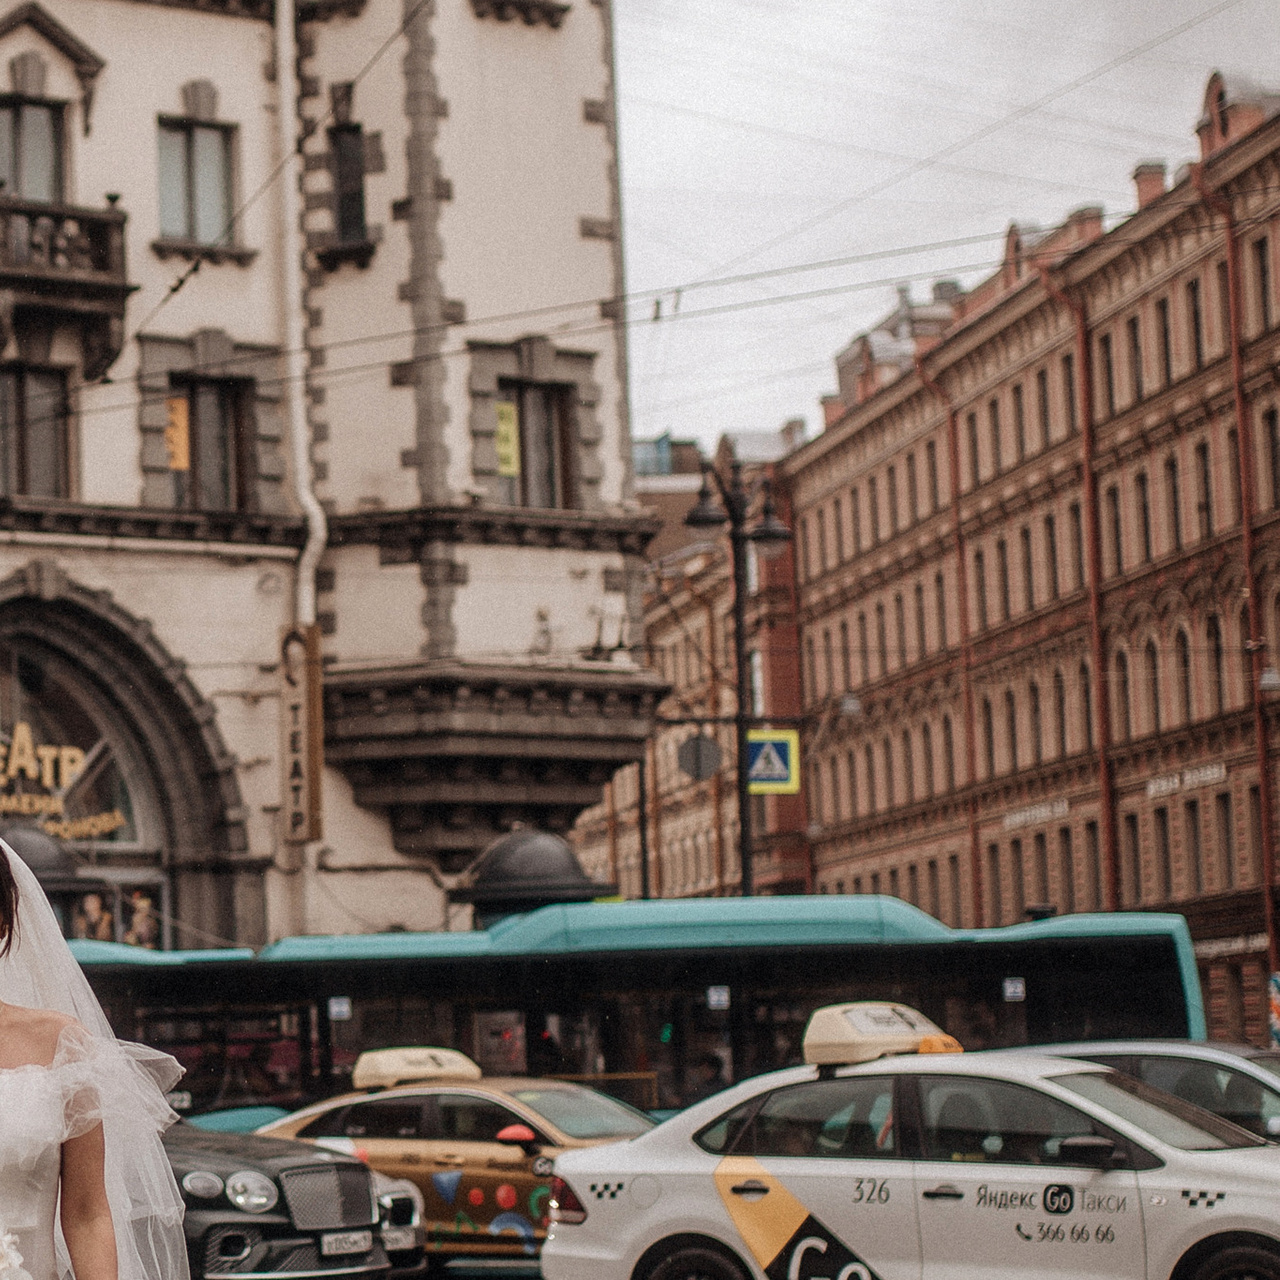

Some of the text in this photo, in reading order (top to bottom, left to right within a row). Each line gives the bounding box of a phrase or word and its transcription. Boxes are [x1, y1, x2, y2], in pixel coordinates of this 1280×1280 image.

[289, 703, 304, 833] ТЕАТР
[851, 1177, 890, 1205] 326
[976, 1184, 1127, 1213] Яндекс Go Такси
[1037, 1222, 1115, 1244] 366 66 66
